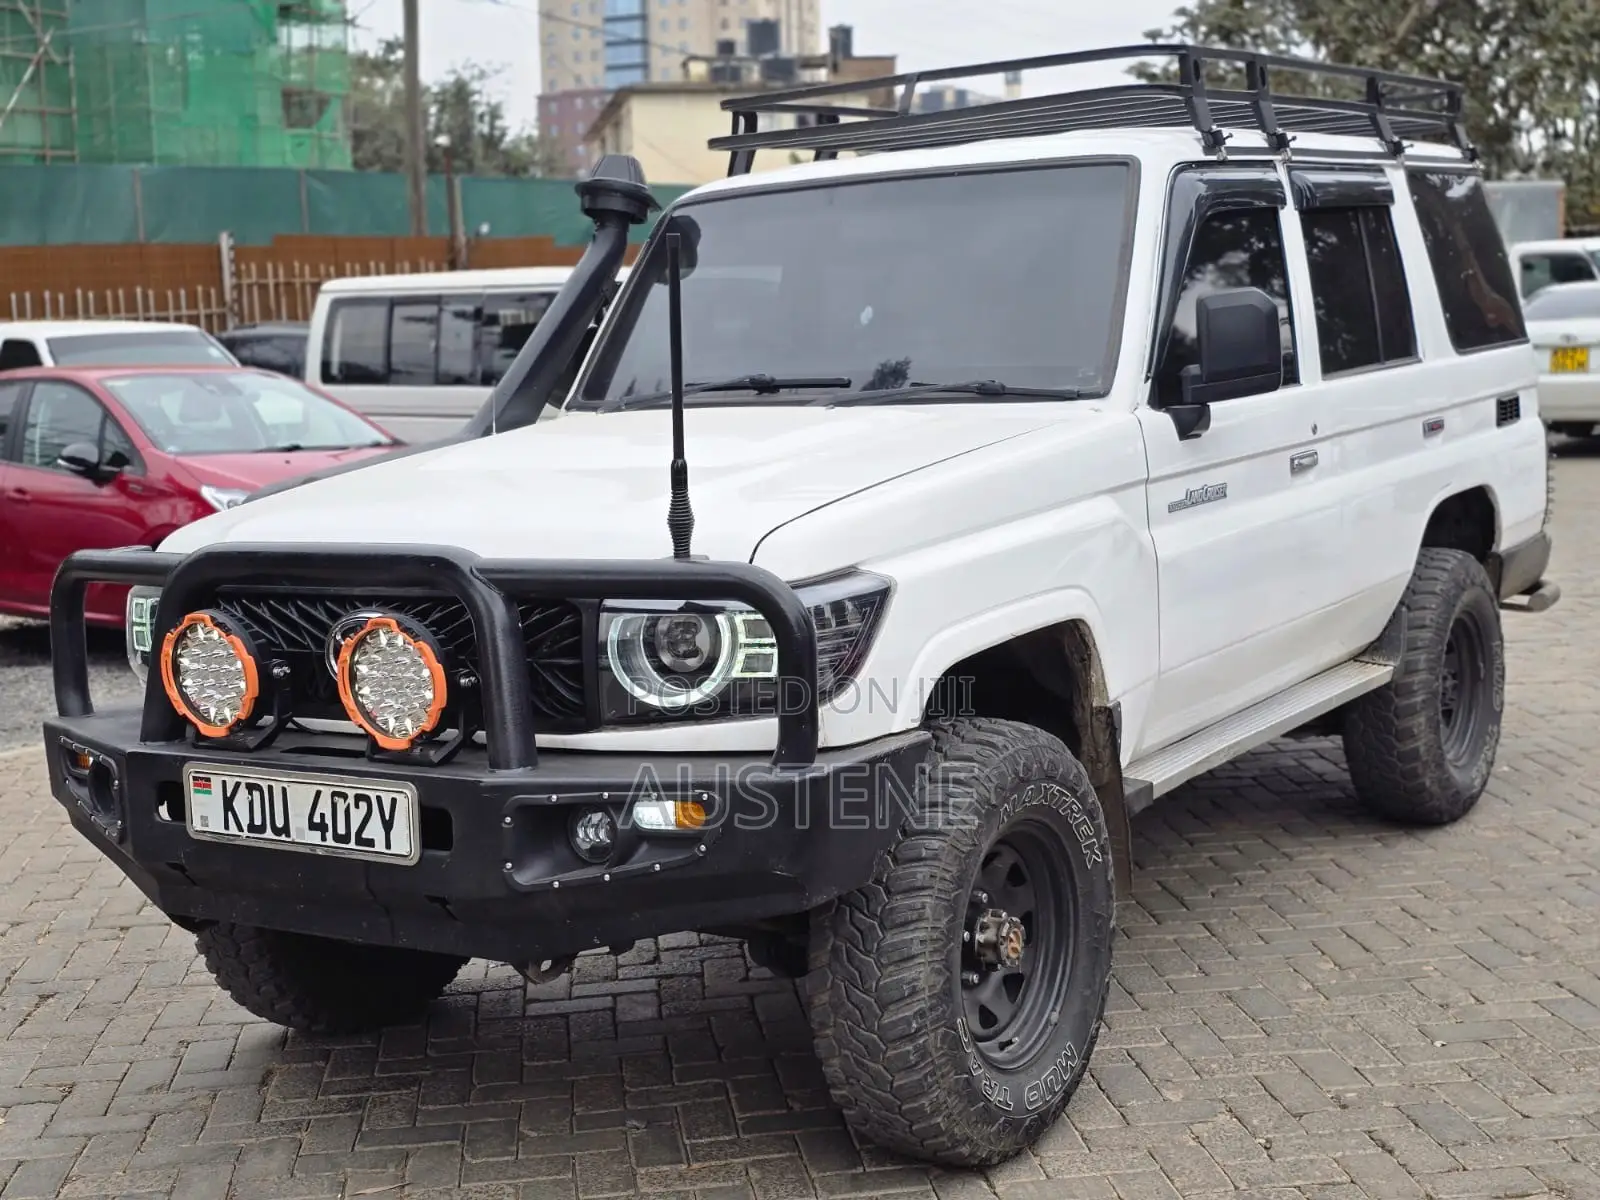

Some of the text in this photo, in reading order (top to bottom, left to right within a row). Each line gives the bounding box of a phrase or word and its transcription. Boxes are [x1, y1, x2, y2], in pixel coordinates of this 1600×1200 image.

[221, 779, 398, 850] KDU 402Y
[1000, 783, 1103, 870] MAXTREK
[957, 1016, 1078, 1111] MUD TRAC
